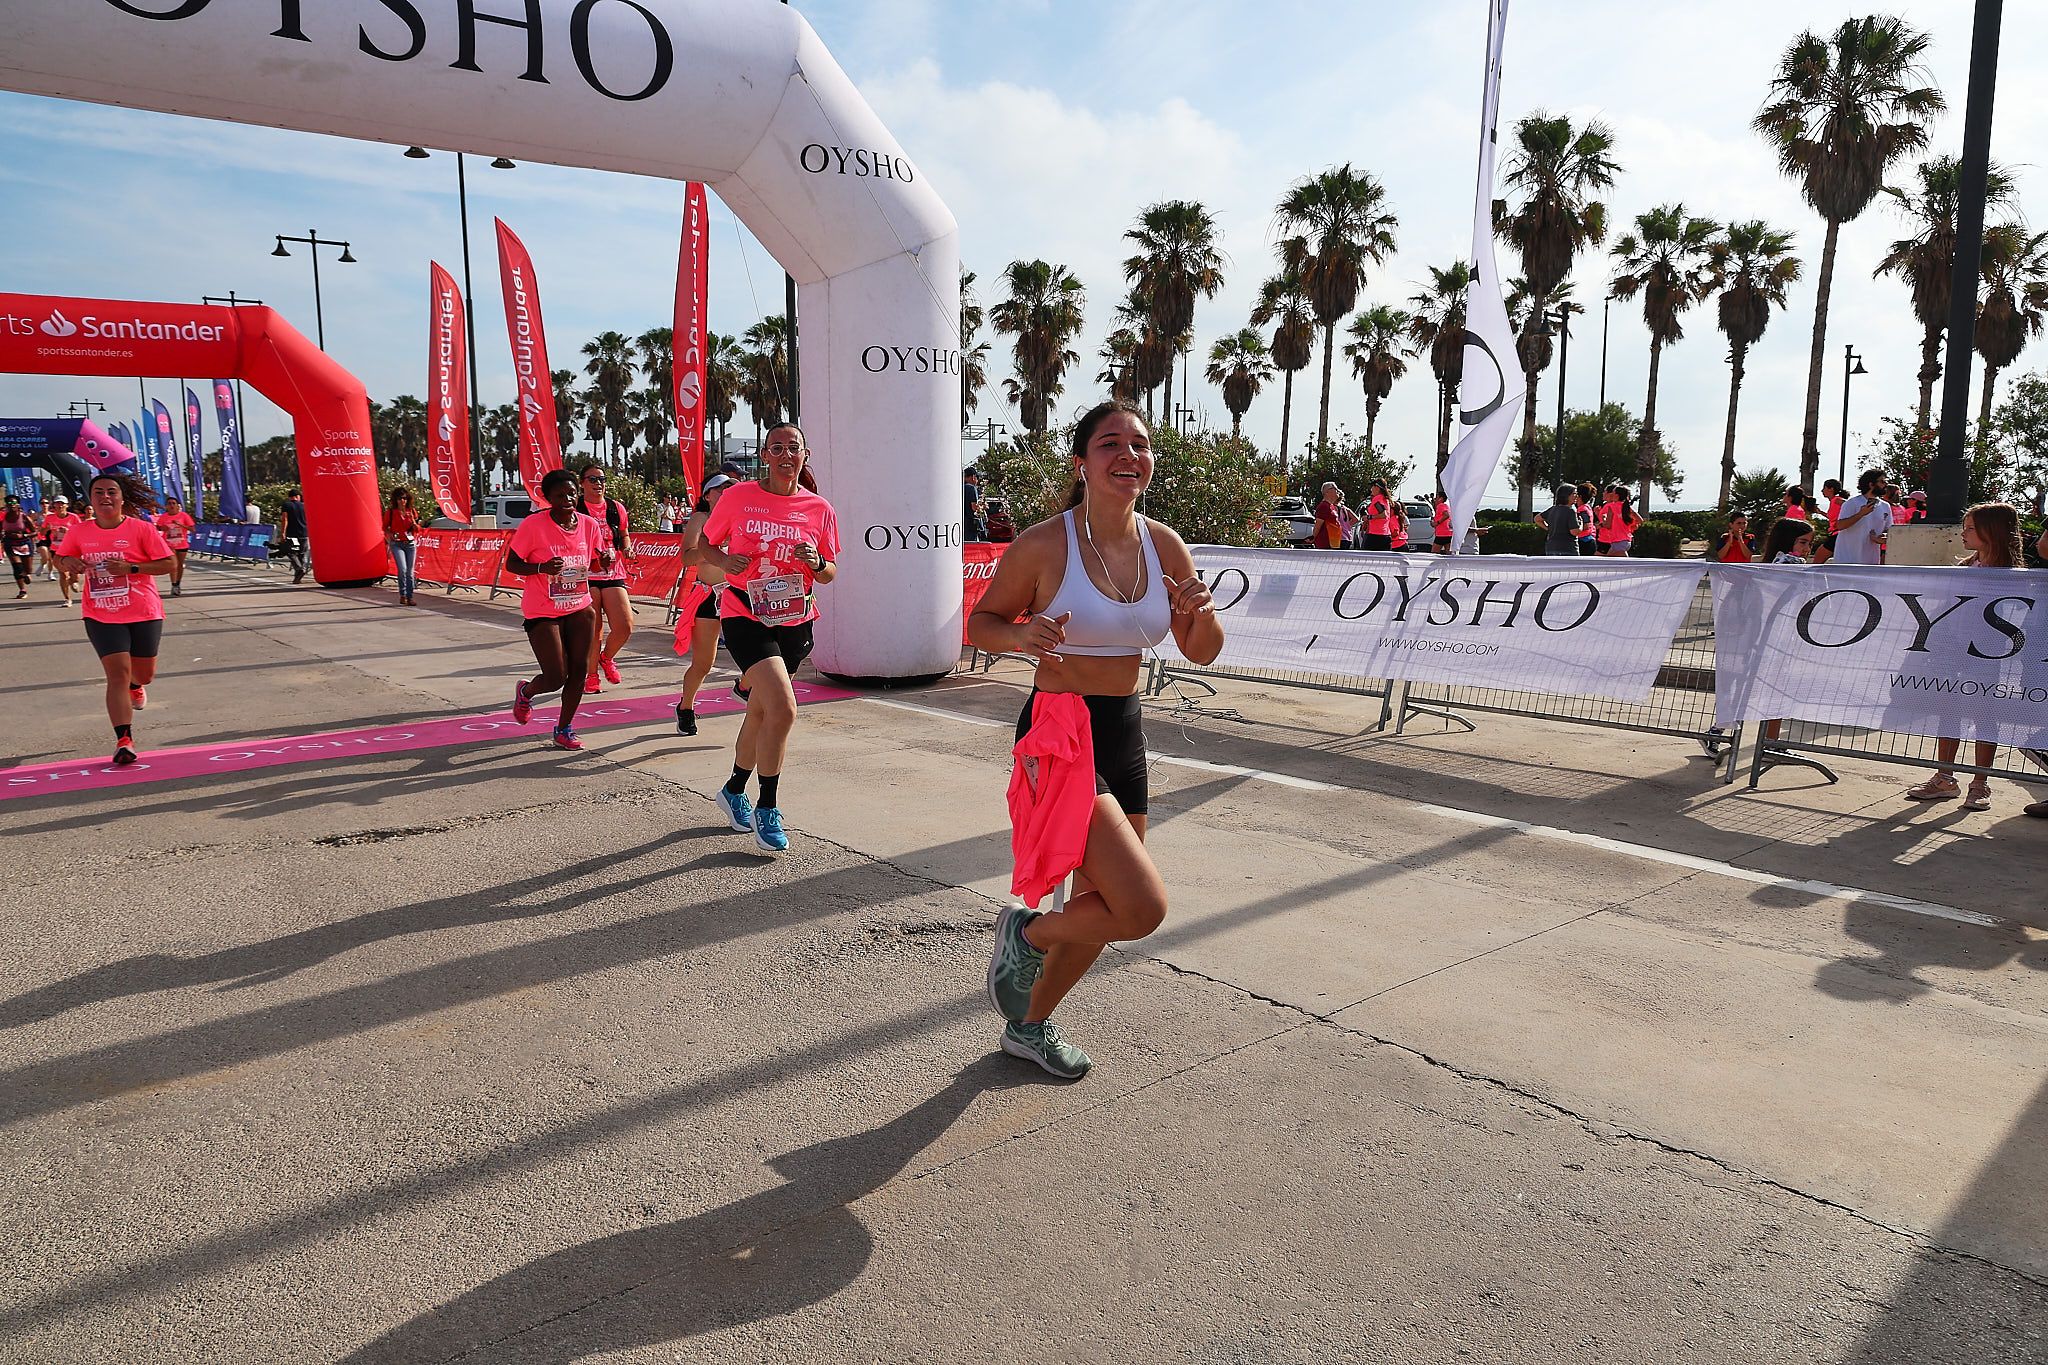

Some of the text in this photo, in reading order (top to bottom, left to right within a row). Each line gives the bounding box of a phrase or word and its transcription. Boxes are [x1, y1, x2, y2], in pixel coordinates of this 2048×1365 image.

[105, 0, 674, 101] SHO
[800, 143, 914, 183] OYSHO
[82, 316, 224, 342] Santander
[37, 347, 133, 358] sportssantander.es
[861, 345, 960, 376] OYSHO
[324, 429, 359, 441] Sports
[323, 446, 372, 456] Santander
[744, 506, 769, 514] OYSHO
[864, 523, 961, 551] OYSHO
[635, 541, 680, 557] Santander
[98, 576, 114, 585] 016
[562, 582, 577, 590] 016
[770, 599, 790, 610] 016
[1332, 571, 1601, 632] OYSHO
[1796, 589, 2048, 664] OYS
[1378, 636, 1500, 657] WWW.OYSHO.COM
[208, 732, 415, 762] OYSHO
